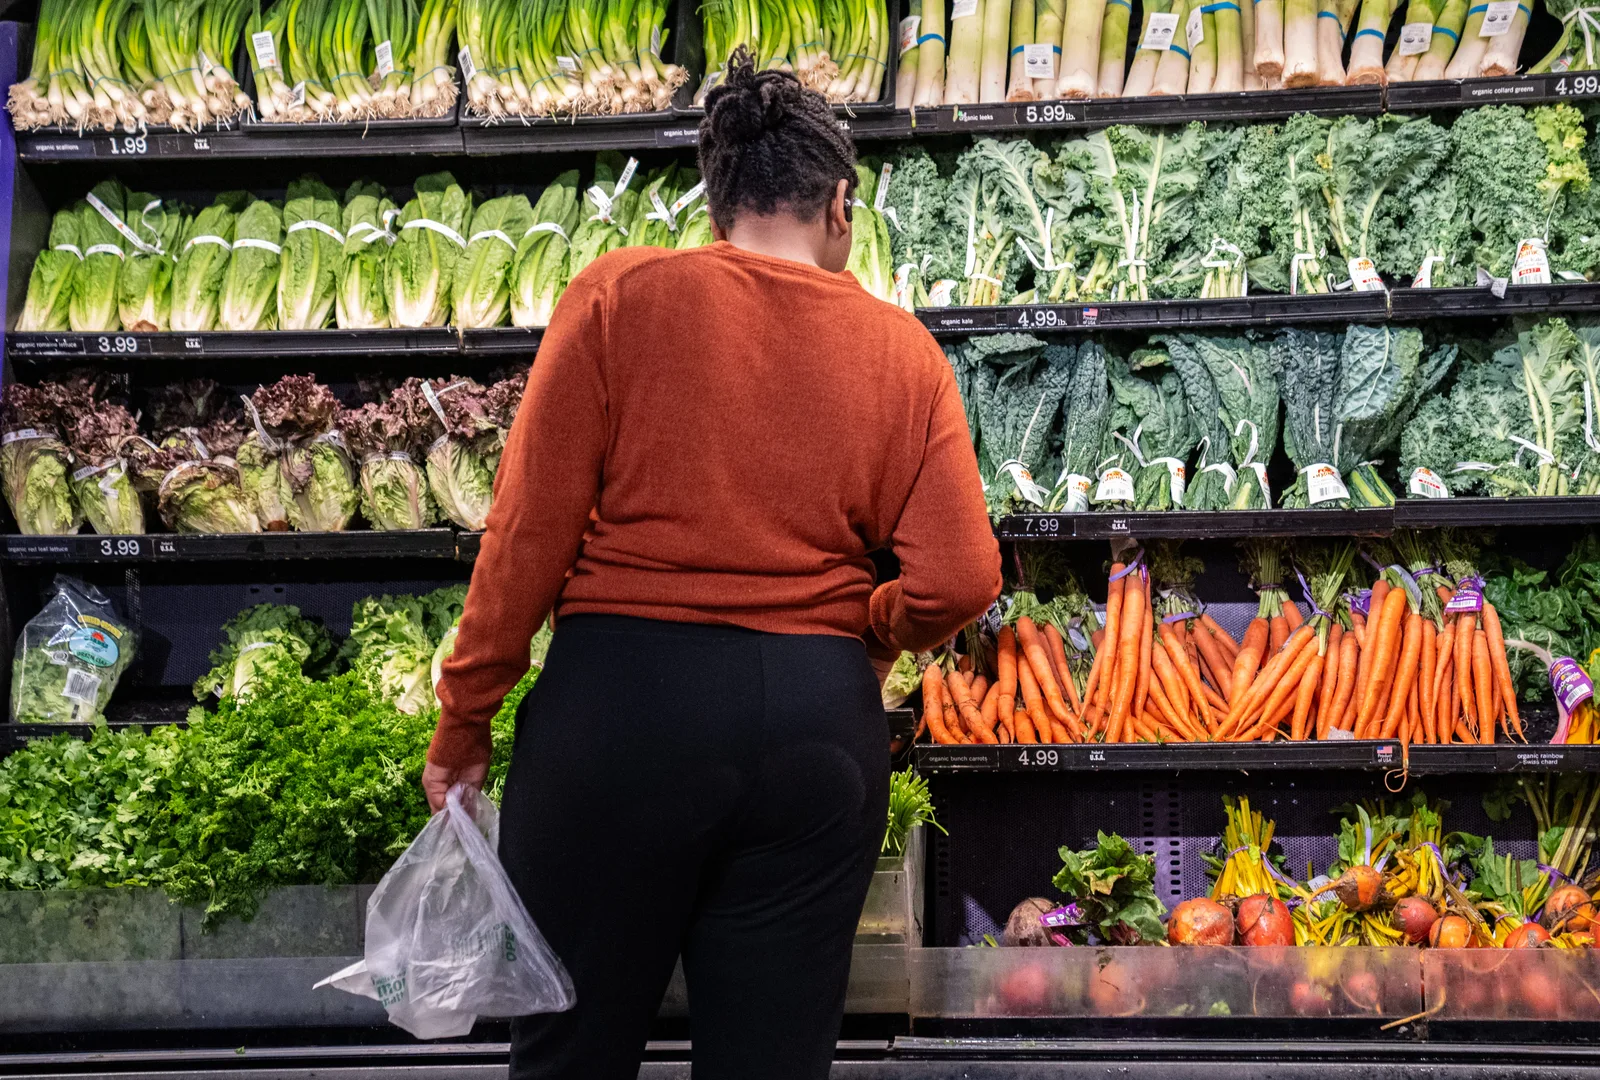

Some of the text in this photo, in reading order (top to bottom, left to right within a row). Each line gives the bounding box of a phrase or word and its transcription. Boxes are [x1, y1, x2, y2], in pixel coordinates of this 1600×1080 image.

[1472, 85, 1534, 96] organic collard greens
[1555, 76, 1597, 95] 4.99
[1026, 105, 1065, 122] 5.99
[663, 129, 683, 137] organic
[110, 137, 147, 154] 1.99
[1018, 310, 1057, 327] 4.99
[98, 336, 137, 353] 3.99
[1024, 518, 1059, 532] 7.99
[100, 539, 140, 556] 3.99
[1018, 750, 1059, 766] 4.99
